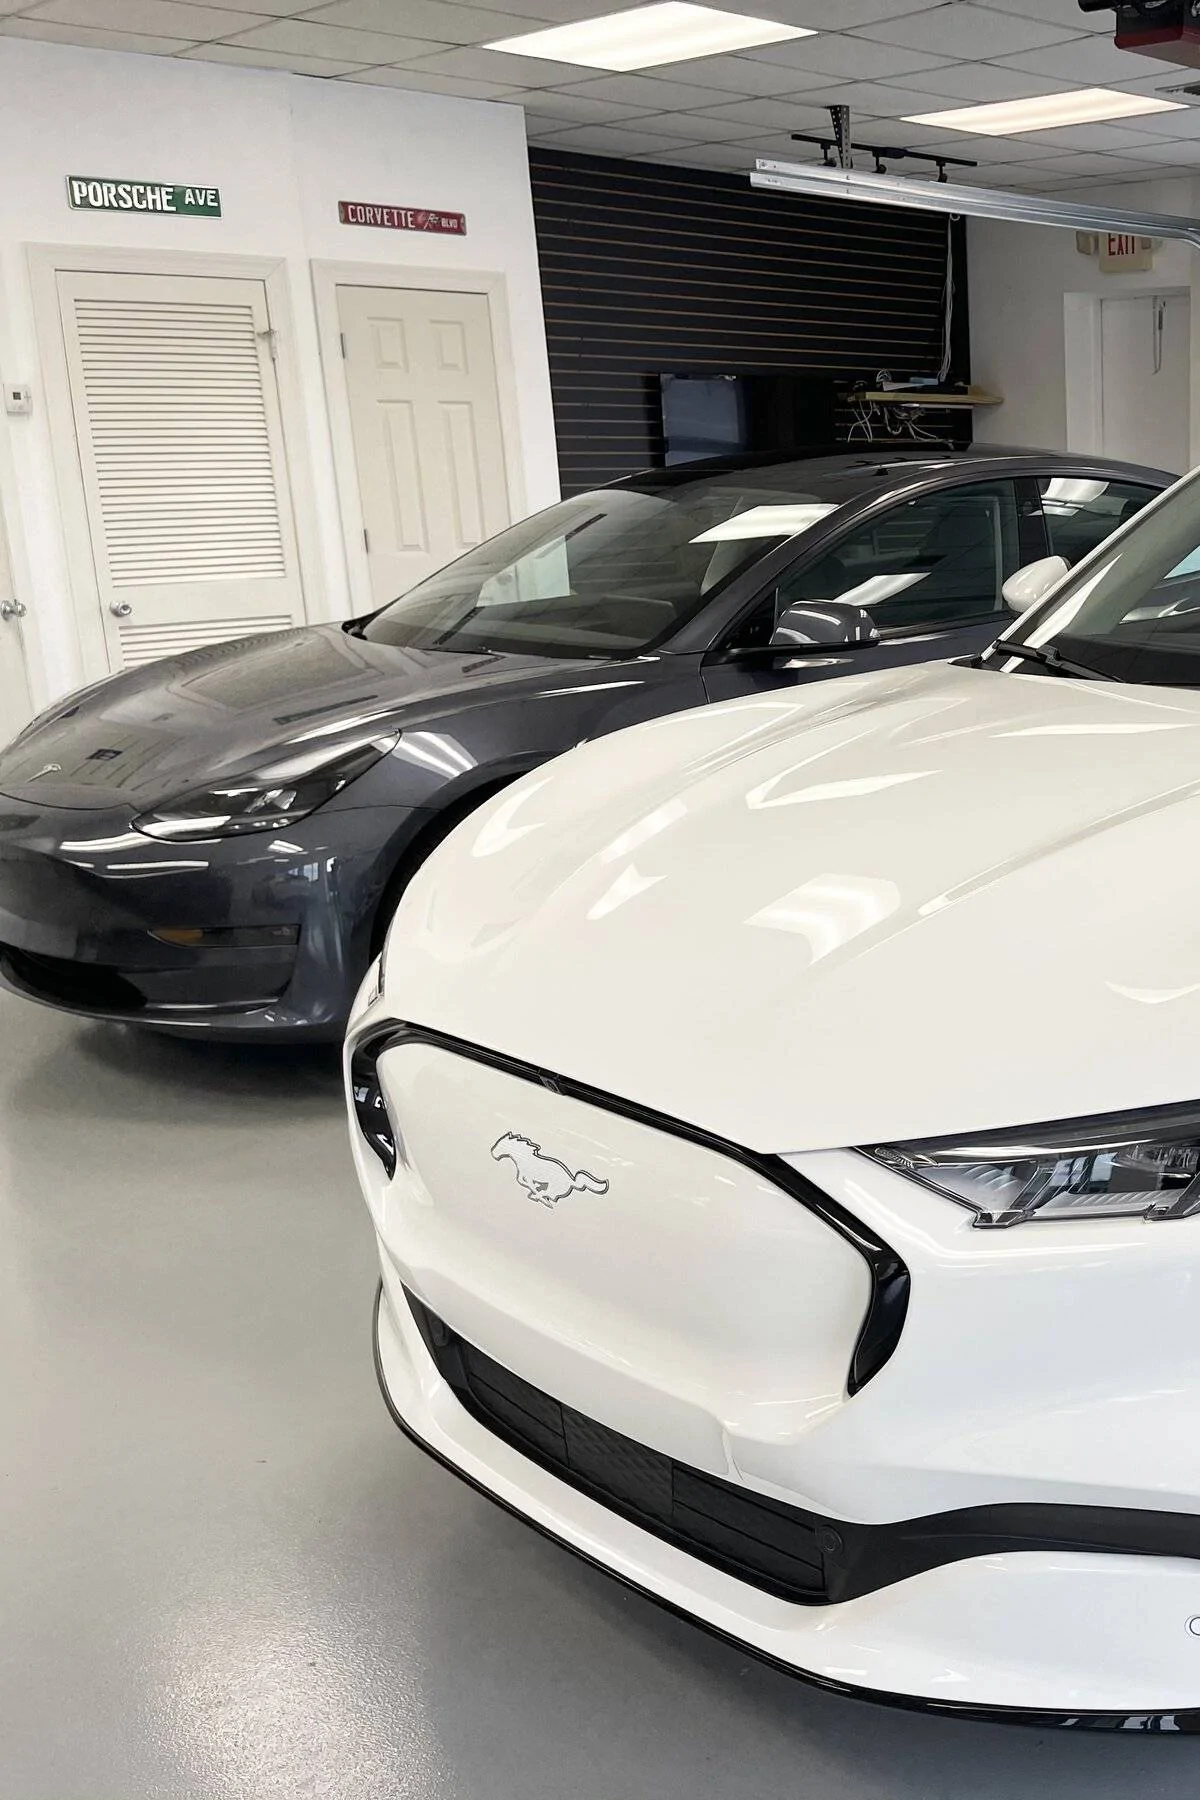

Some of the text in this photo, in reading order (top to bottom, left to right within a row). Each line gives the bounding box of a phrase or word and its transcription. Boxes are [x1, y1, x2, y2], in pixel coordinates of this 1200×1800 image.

[71, 180, 218, 212] PORSCHE AVE
[347, 205, 415, 228] CORVETTE
